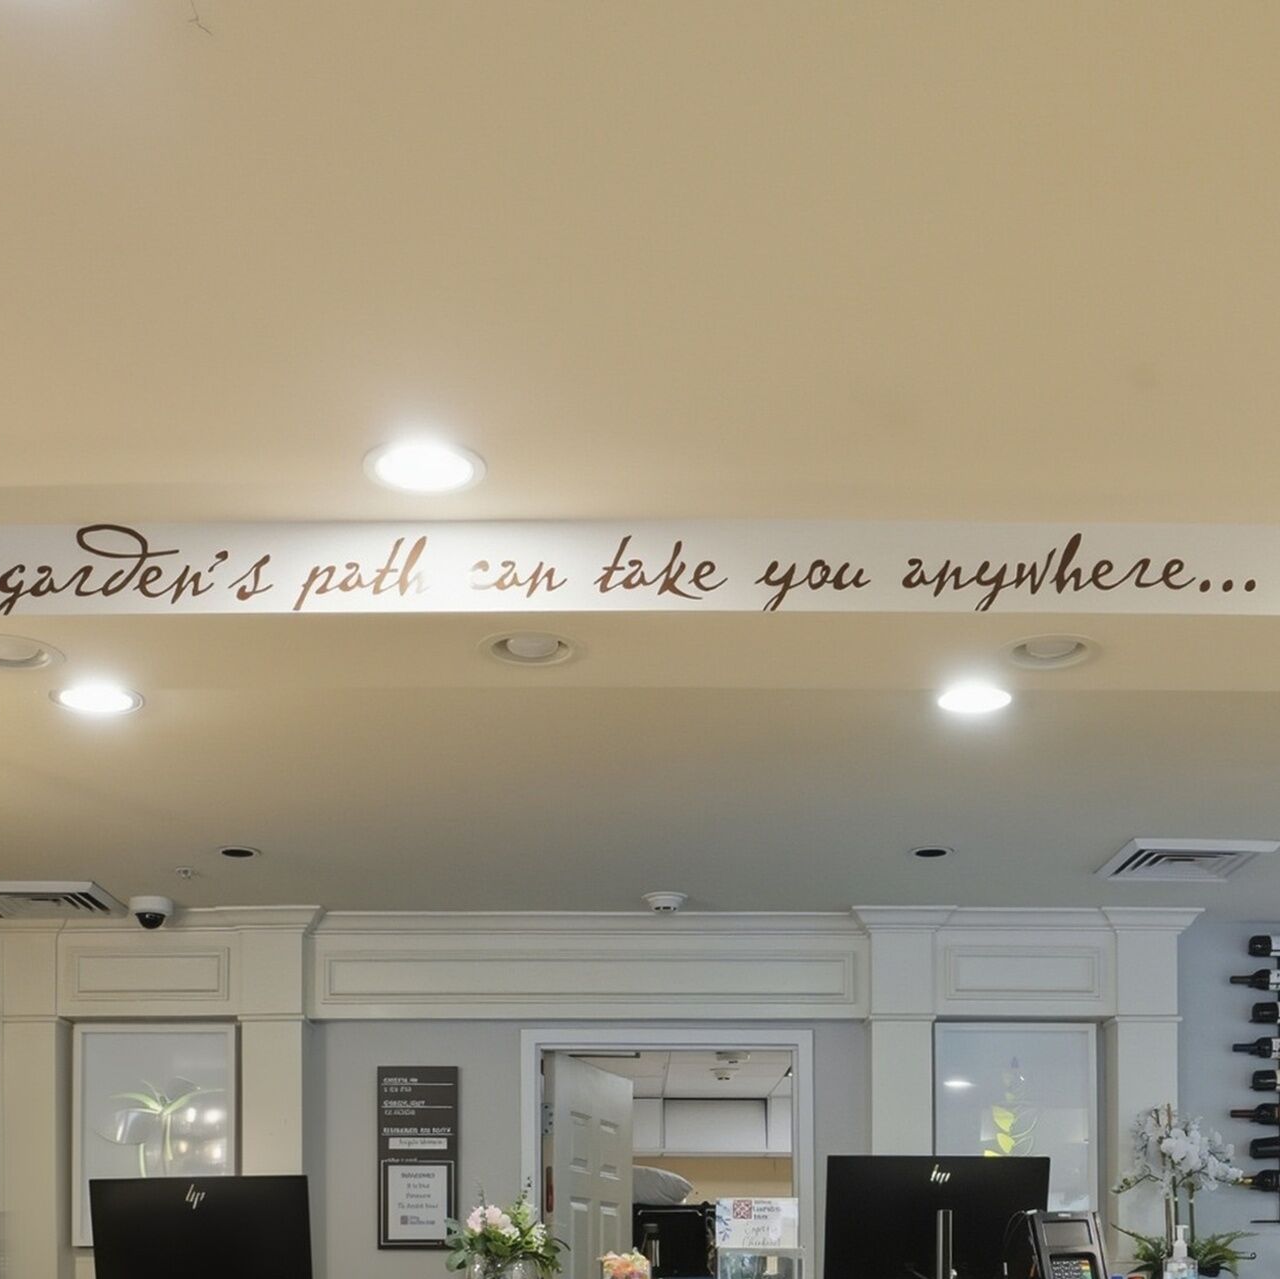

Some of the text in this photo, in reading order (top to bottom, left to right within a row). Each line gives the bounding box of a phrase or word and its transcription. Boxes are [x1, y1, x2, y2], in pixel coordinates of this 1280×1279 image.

[293, 535, 428, 611] path
[469, 558, 568, 598] can
[594, 535, 728, 600] take
[754, 558, 871, 612] you
[901, 532, 1258, 612] anywhere...
